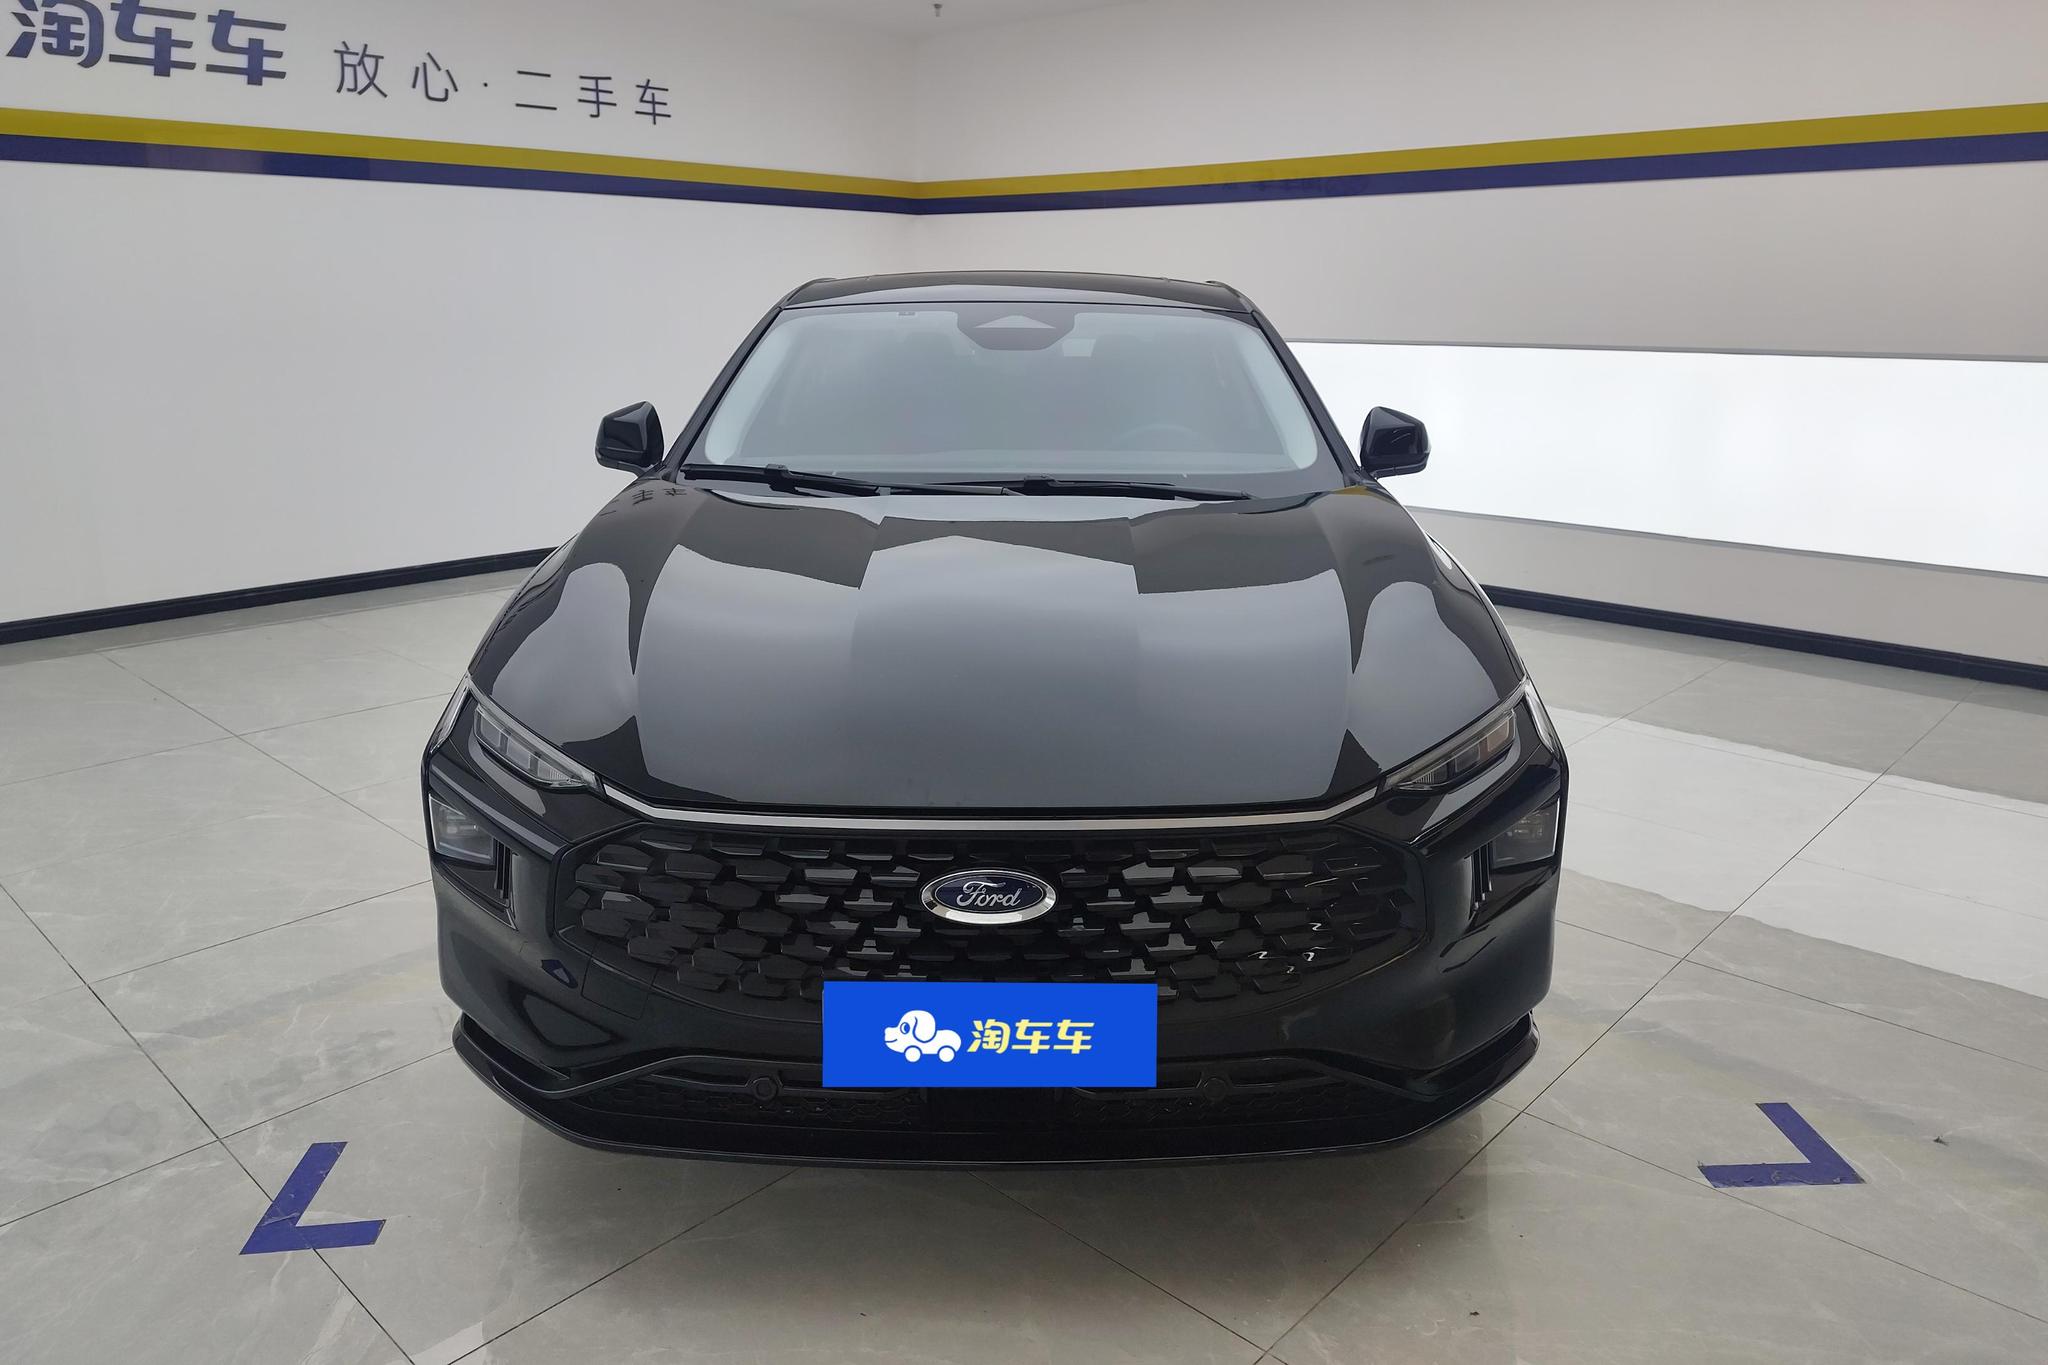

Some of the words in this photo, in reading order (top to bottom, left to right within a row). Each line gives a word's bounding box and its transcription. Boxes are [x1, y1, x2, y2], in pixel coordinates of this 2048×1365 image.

[6, 0, 287, 86] 淘车车
[956, 881, 1022, 907] Ford
